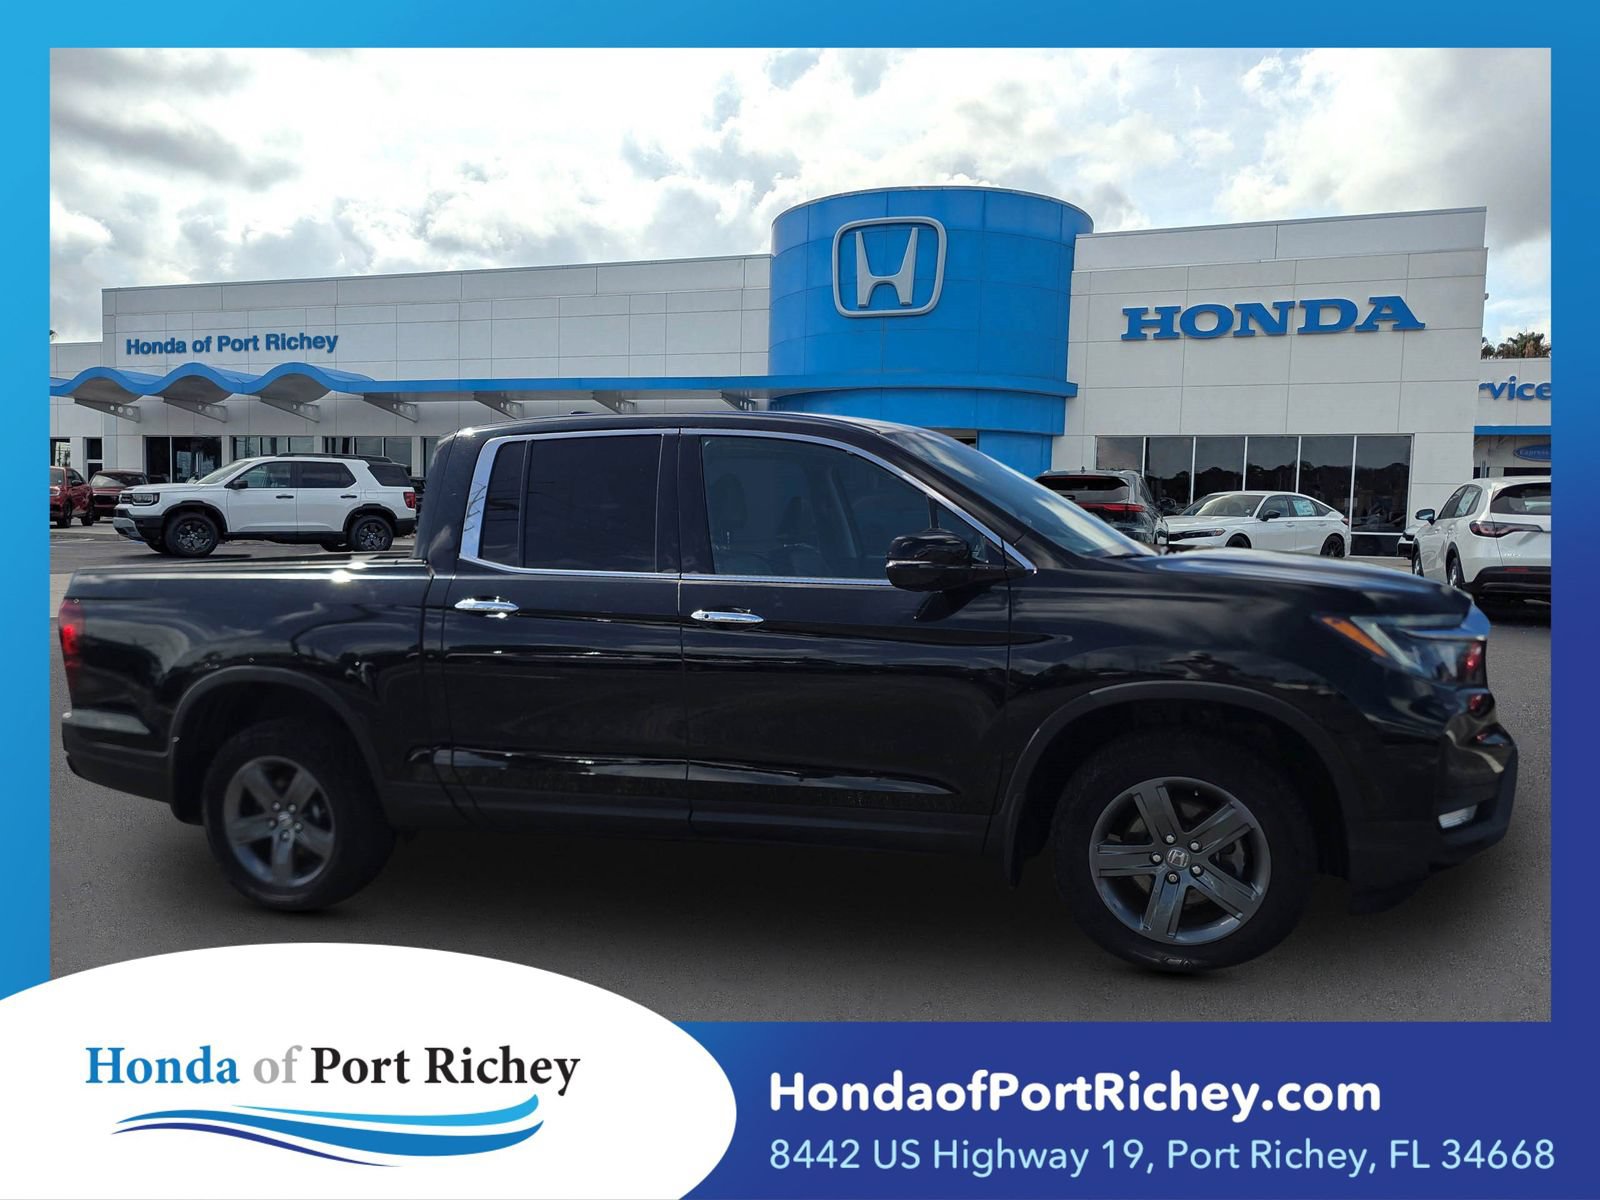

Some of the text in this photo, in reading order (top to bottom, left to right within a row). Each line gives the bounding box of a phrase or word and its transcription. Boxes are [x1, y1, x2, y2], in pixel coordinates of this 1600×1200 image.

[1120, 295, 1425, 340] HONDA
[126, 331, 339, 355] Honda of Port Richey
